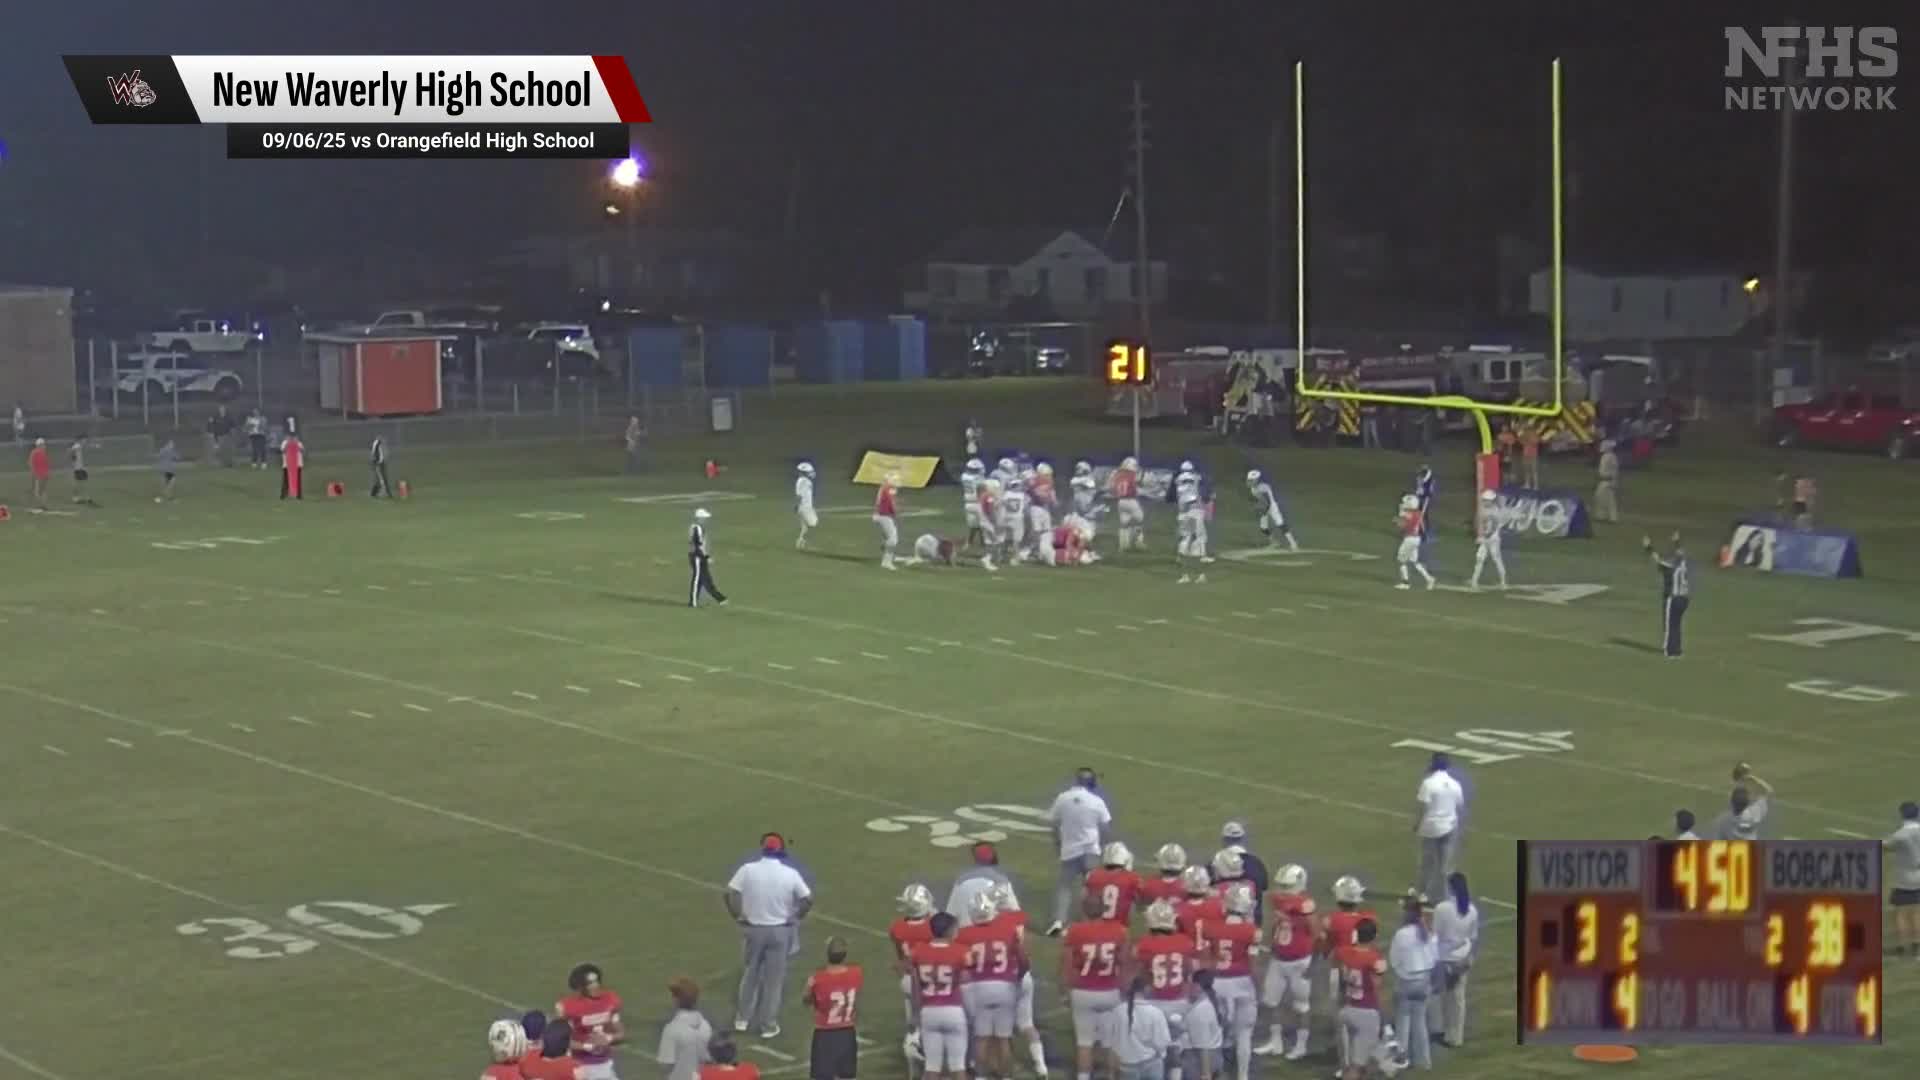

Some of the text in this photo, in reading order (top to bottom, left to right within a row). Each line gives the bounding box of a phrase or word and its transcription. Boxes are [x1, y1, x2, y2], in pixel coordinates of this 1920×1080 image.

[1109, 344, 1146, 381] 21
[1390, 729, 1574, 764] 10
[865, 804, 1054, 848] 20
[1540, 849, 1629, 886] VISITOR
[1772, 852, 1869, 889] BOBCATS
[1102, 884, 1120, 919] 9
[176, 901, 423, 959] 30
[1575, 901, 1599, 965] 3
[1620, 913, 1640, 963] 2
[1764, 914, 1784, 966] 2
[971, 941, 1008, 974] 73
[1081, 943, 1117, 977] 75
[1152, 952, 1183, 989] 63
[917, 964, 953, 997] 55
[827, 987, 857, 1025] 21
[1534, 971, 1550, 1031] 1
[1615, 970, 1639, 1031] 4
[1786, 975, 1809, 1036] 4
[1856, 977, 1877, 1037] 4
